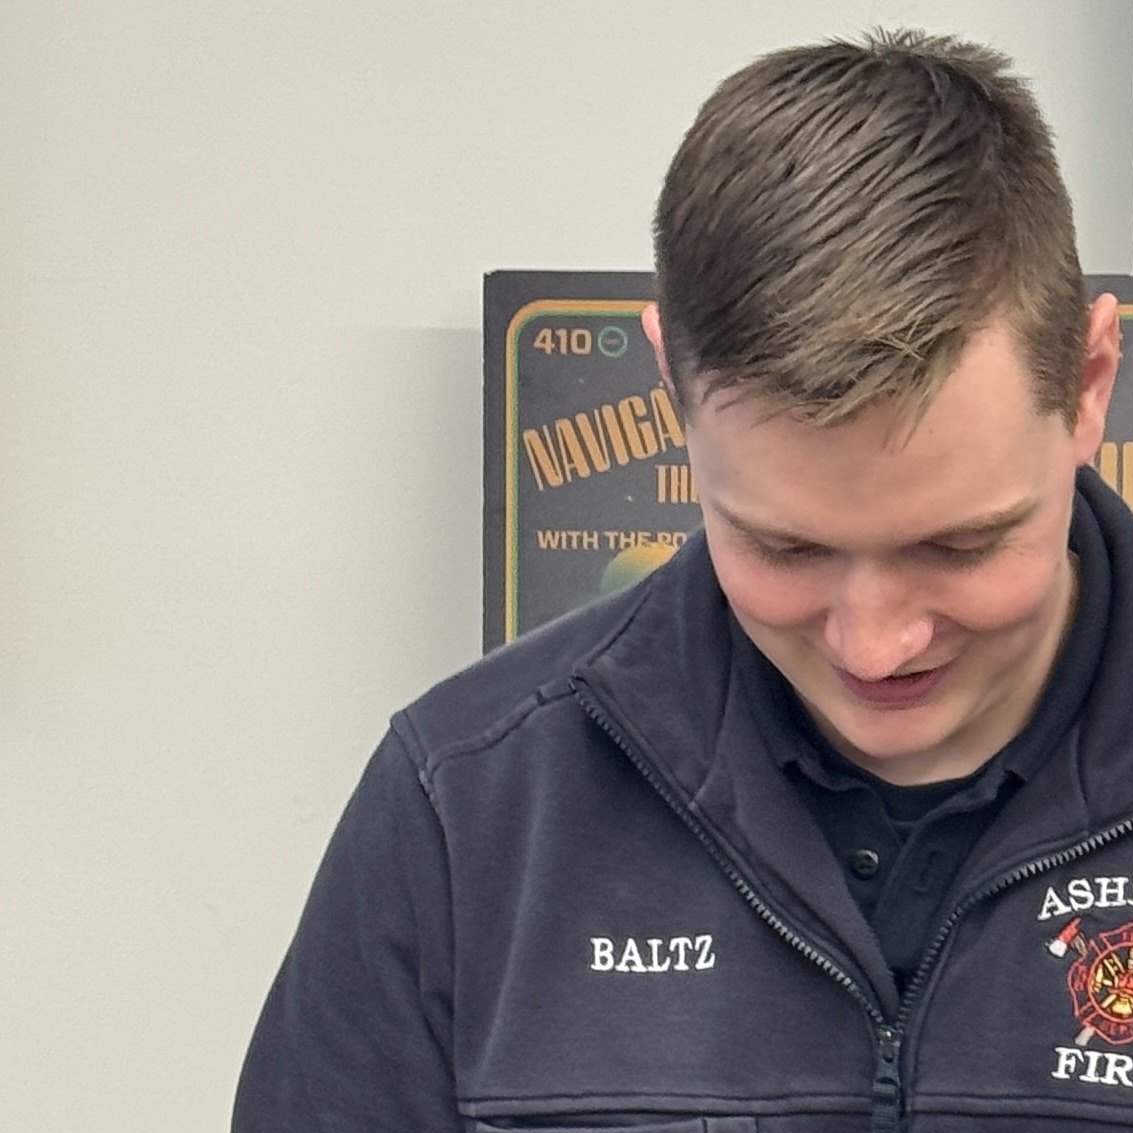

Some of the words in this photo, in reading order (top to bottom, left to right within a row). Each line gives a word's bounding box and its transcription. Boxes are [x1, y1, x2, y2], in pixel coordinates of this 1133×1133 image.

[533, 328, 592, 355] 410
[537, 530, 598, 549] WITH
[604, 531, 651, 550] THE
[589, 934, 716, 973] BALTZ
